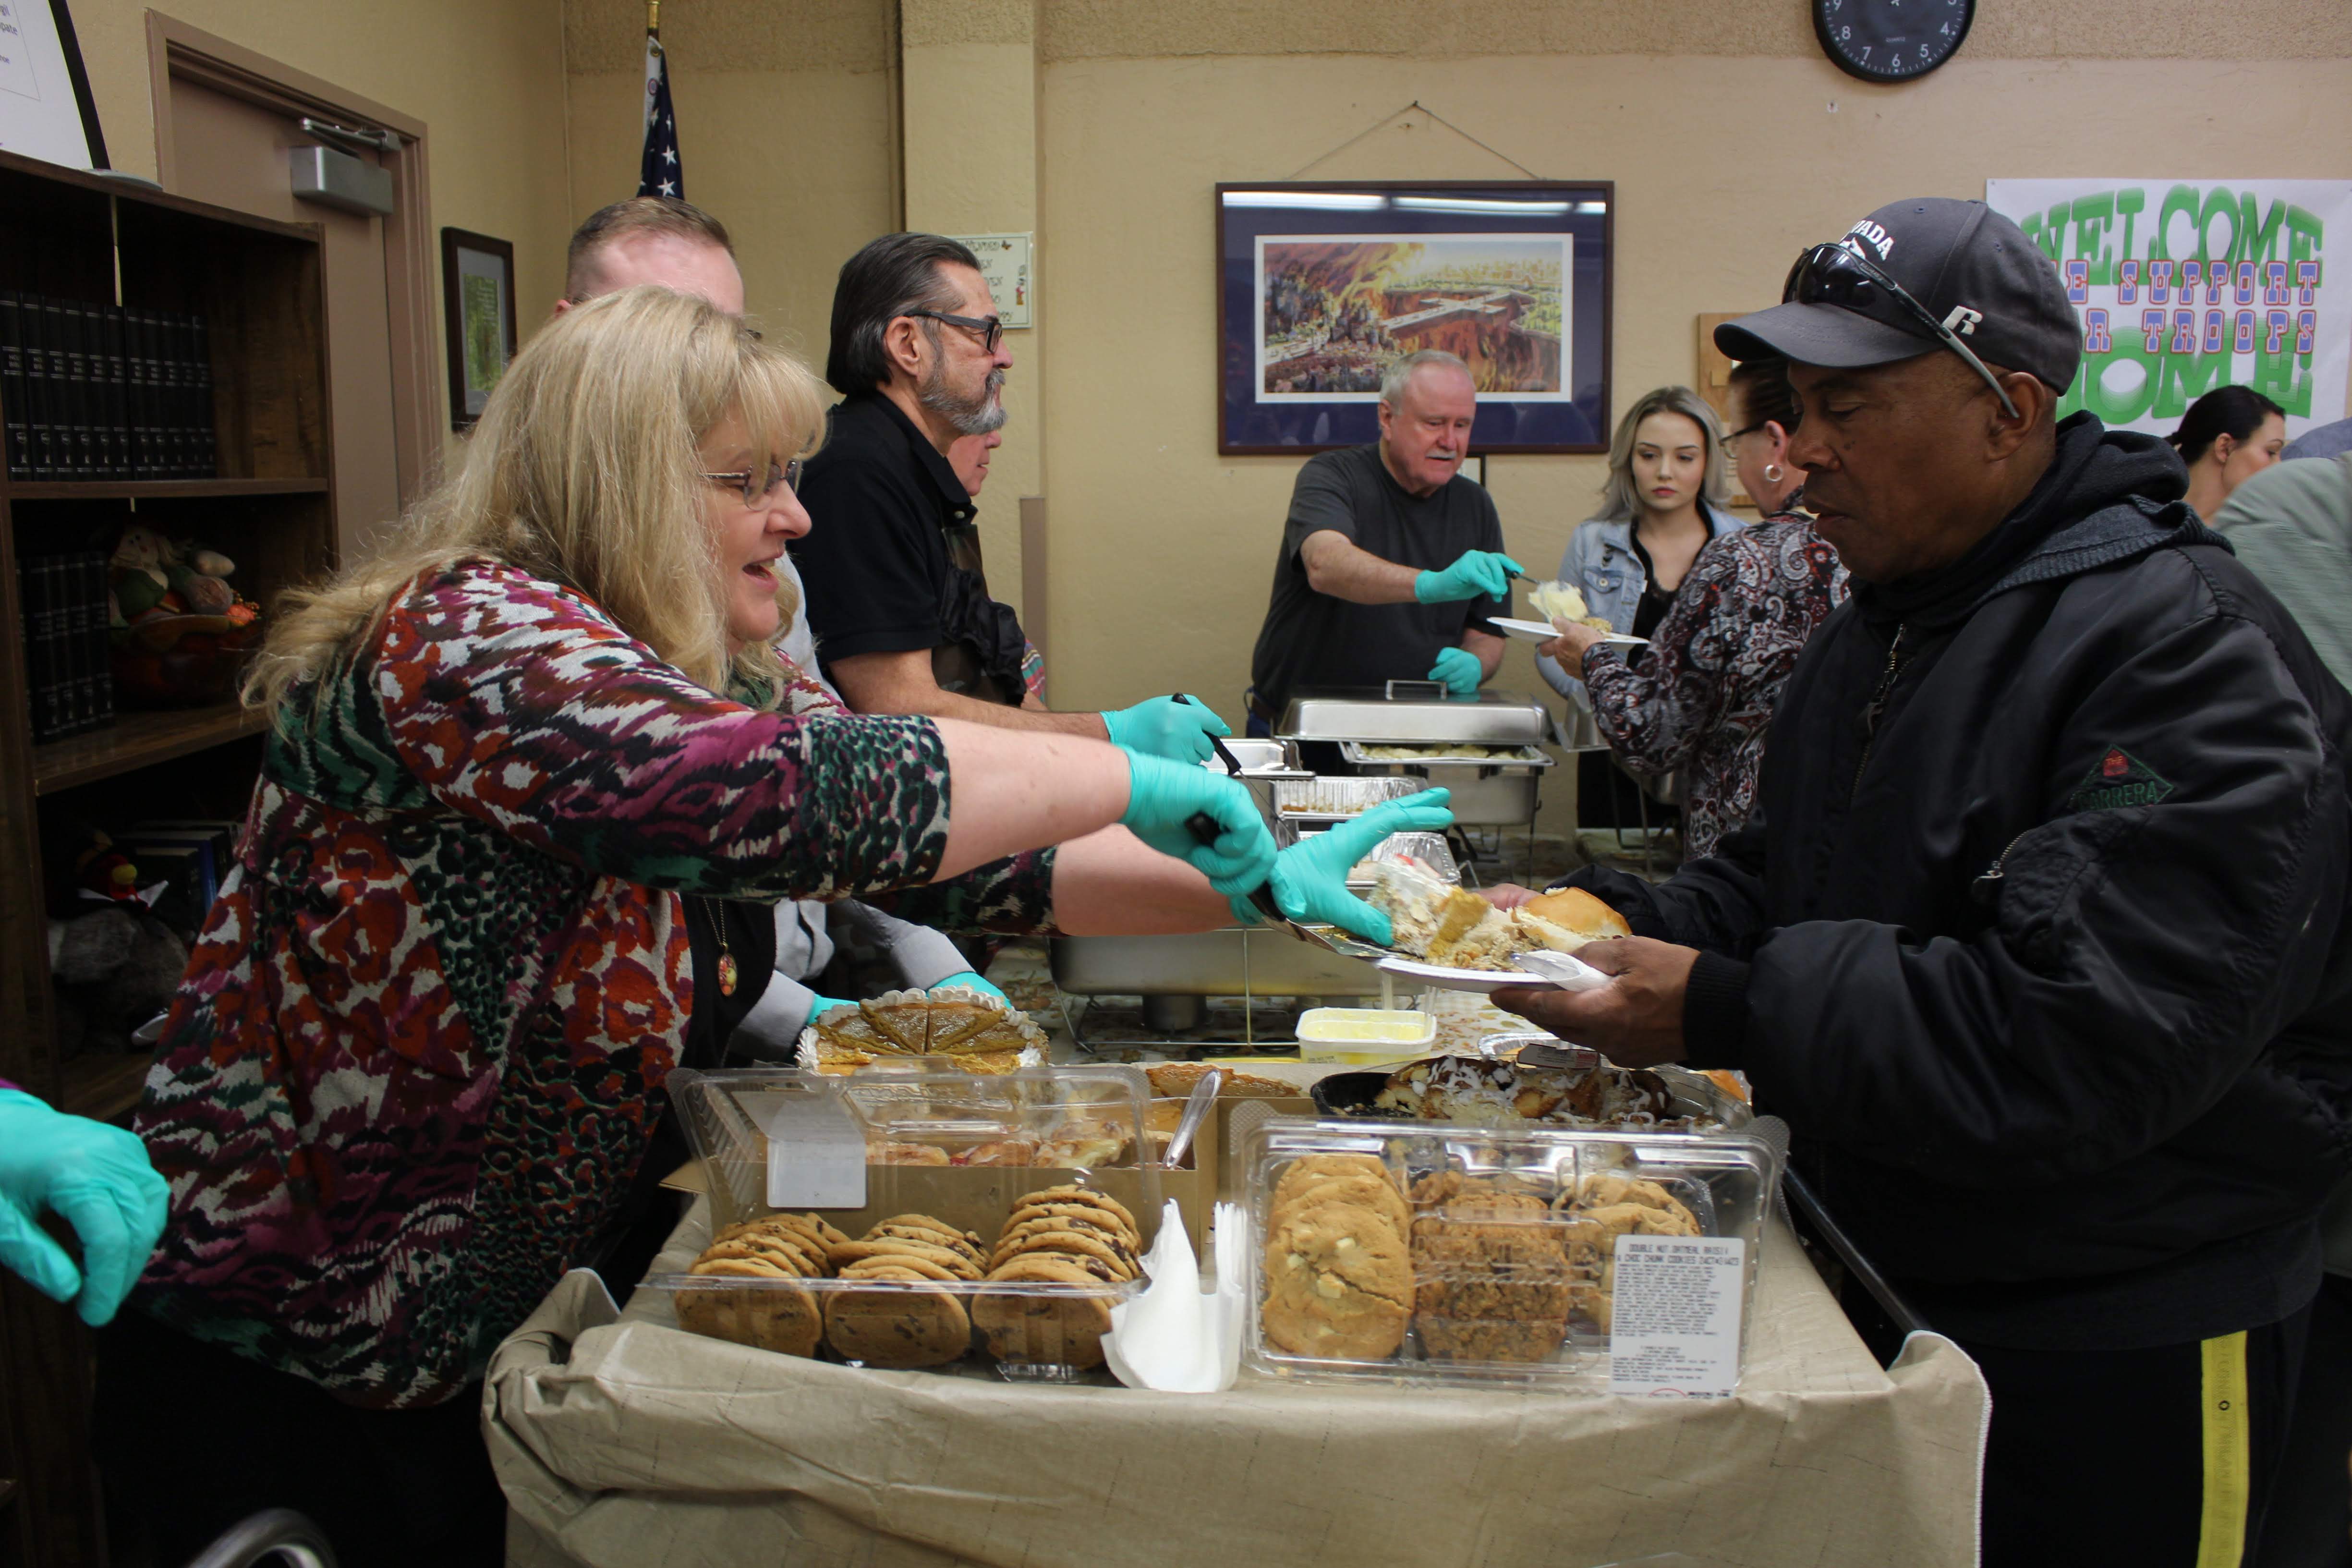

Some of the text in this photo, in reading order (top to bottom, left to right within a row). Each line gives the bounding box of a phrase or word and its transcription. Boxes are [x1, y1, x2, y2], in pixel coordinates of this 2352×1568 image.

[1842, 26, 1851, 39] 8
[1940, 22, 1950, 35] 4
[1862, 47, 1871, 61] 7
[1920, 44, 1929, 58] 5
[1891, 54, 1901, 68] 6
[1848, 219, 1894, 261] VADA
[2020, 183, 2323, 287] WELCOME
[2050, 260, 2320, 306] E SUPPORT
[2142, 308, 2317, 354] TROOPS
[1629, 1244, 1653, 1253] DOUBLE
[1657, 1245, 1668, 1253] NUT
[1672, 1245, 1700, 1254] OATMEAL
[1625, 1254, 1640, 1262] CHOC
[1644, 1254, 1664, 1263] CHUNK
[1667, 1255, 1697, 1264] COOKIES
